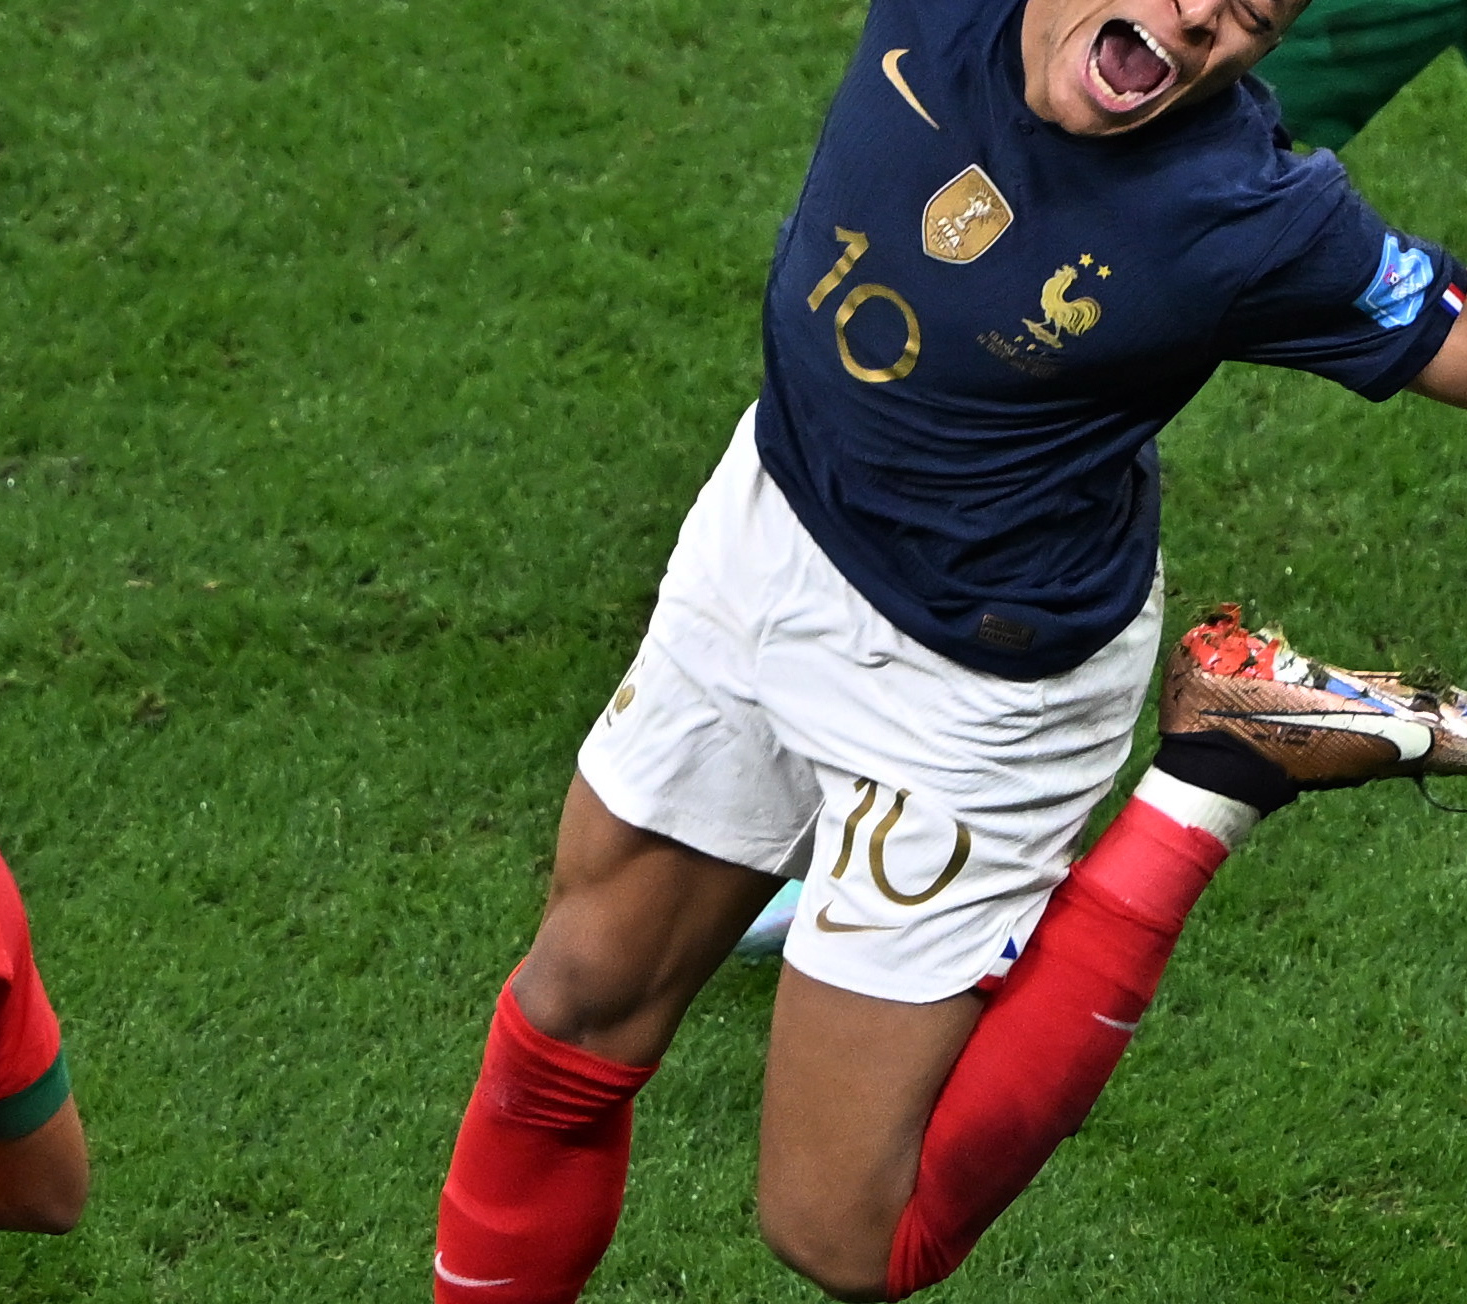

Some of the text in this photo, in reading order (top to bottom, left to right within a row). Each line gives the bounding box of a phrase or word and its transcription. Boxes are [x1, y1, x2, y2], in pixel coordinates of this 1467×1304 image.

[937, 216, 961, 249] FIFA
[805, 223, 922, 384] 10
[830, 775, 972, 908] 10
